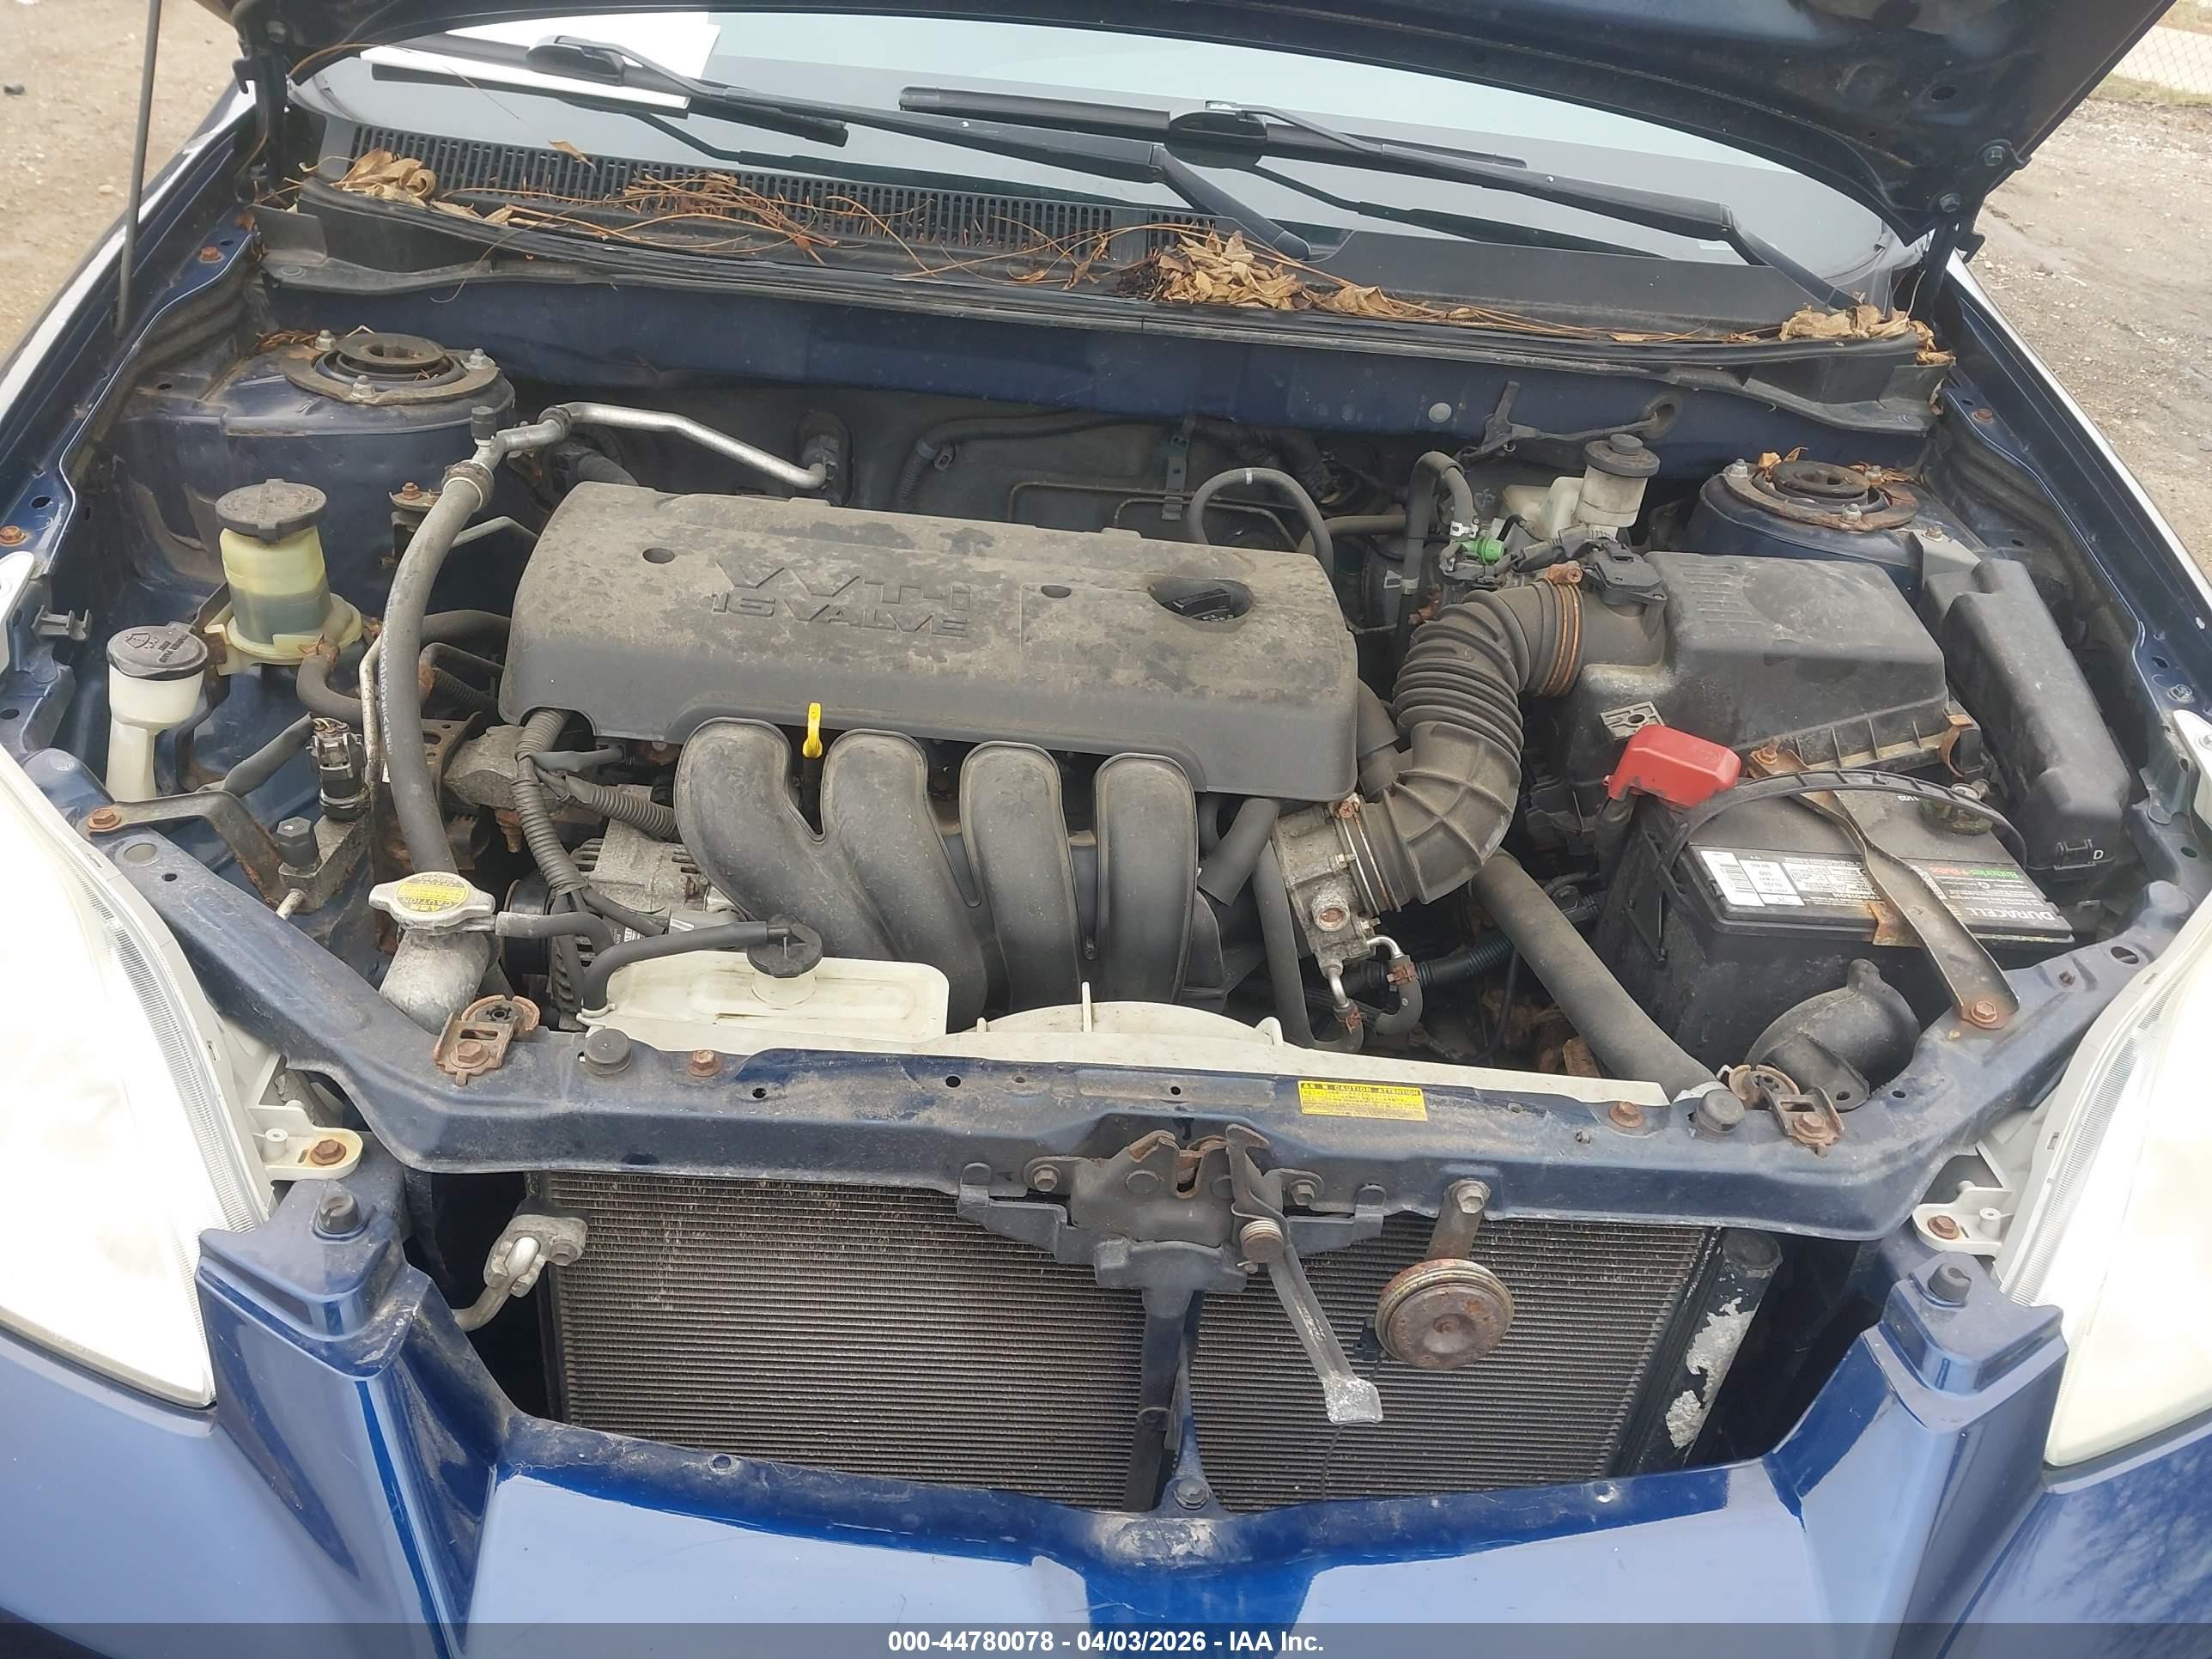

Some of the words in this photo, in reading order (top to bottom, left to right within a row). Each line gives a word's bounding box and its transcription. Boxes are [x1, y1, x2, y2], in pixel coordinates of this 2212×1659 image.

[2094, 849, 2104, 860] D
[403, 897, 452, 907] CAUTION
[1965, 907, 2056, 921] DURACELL
